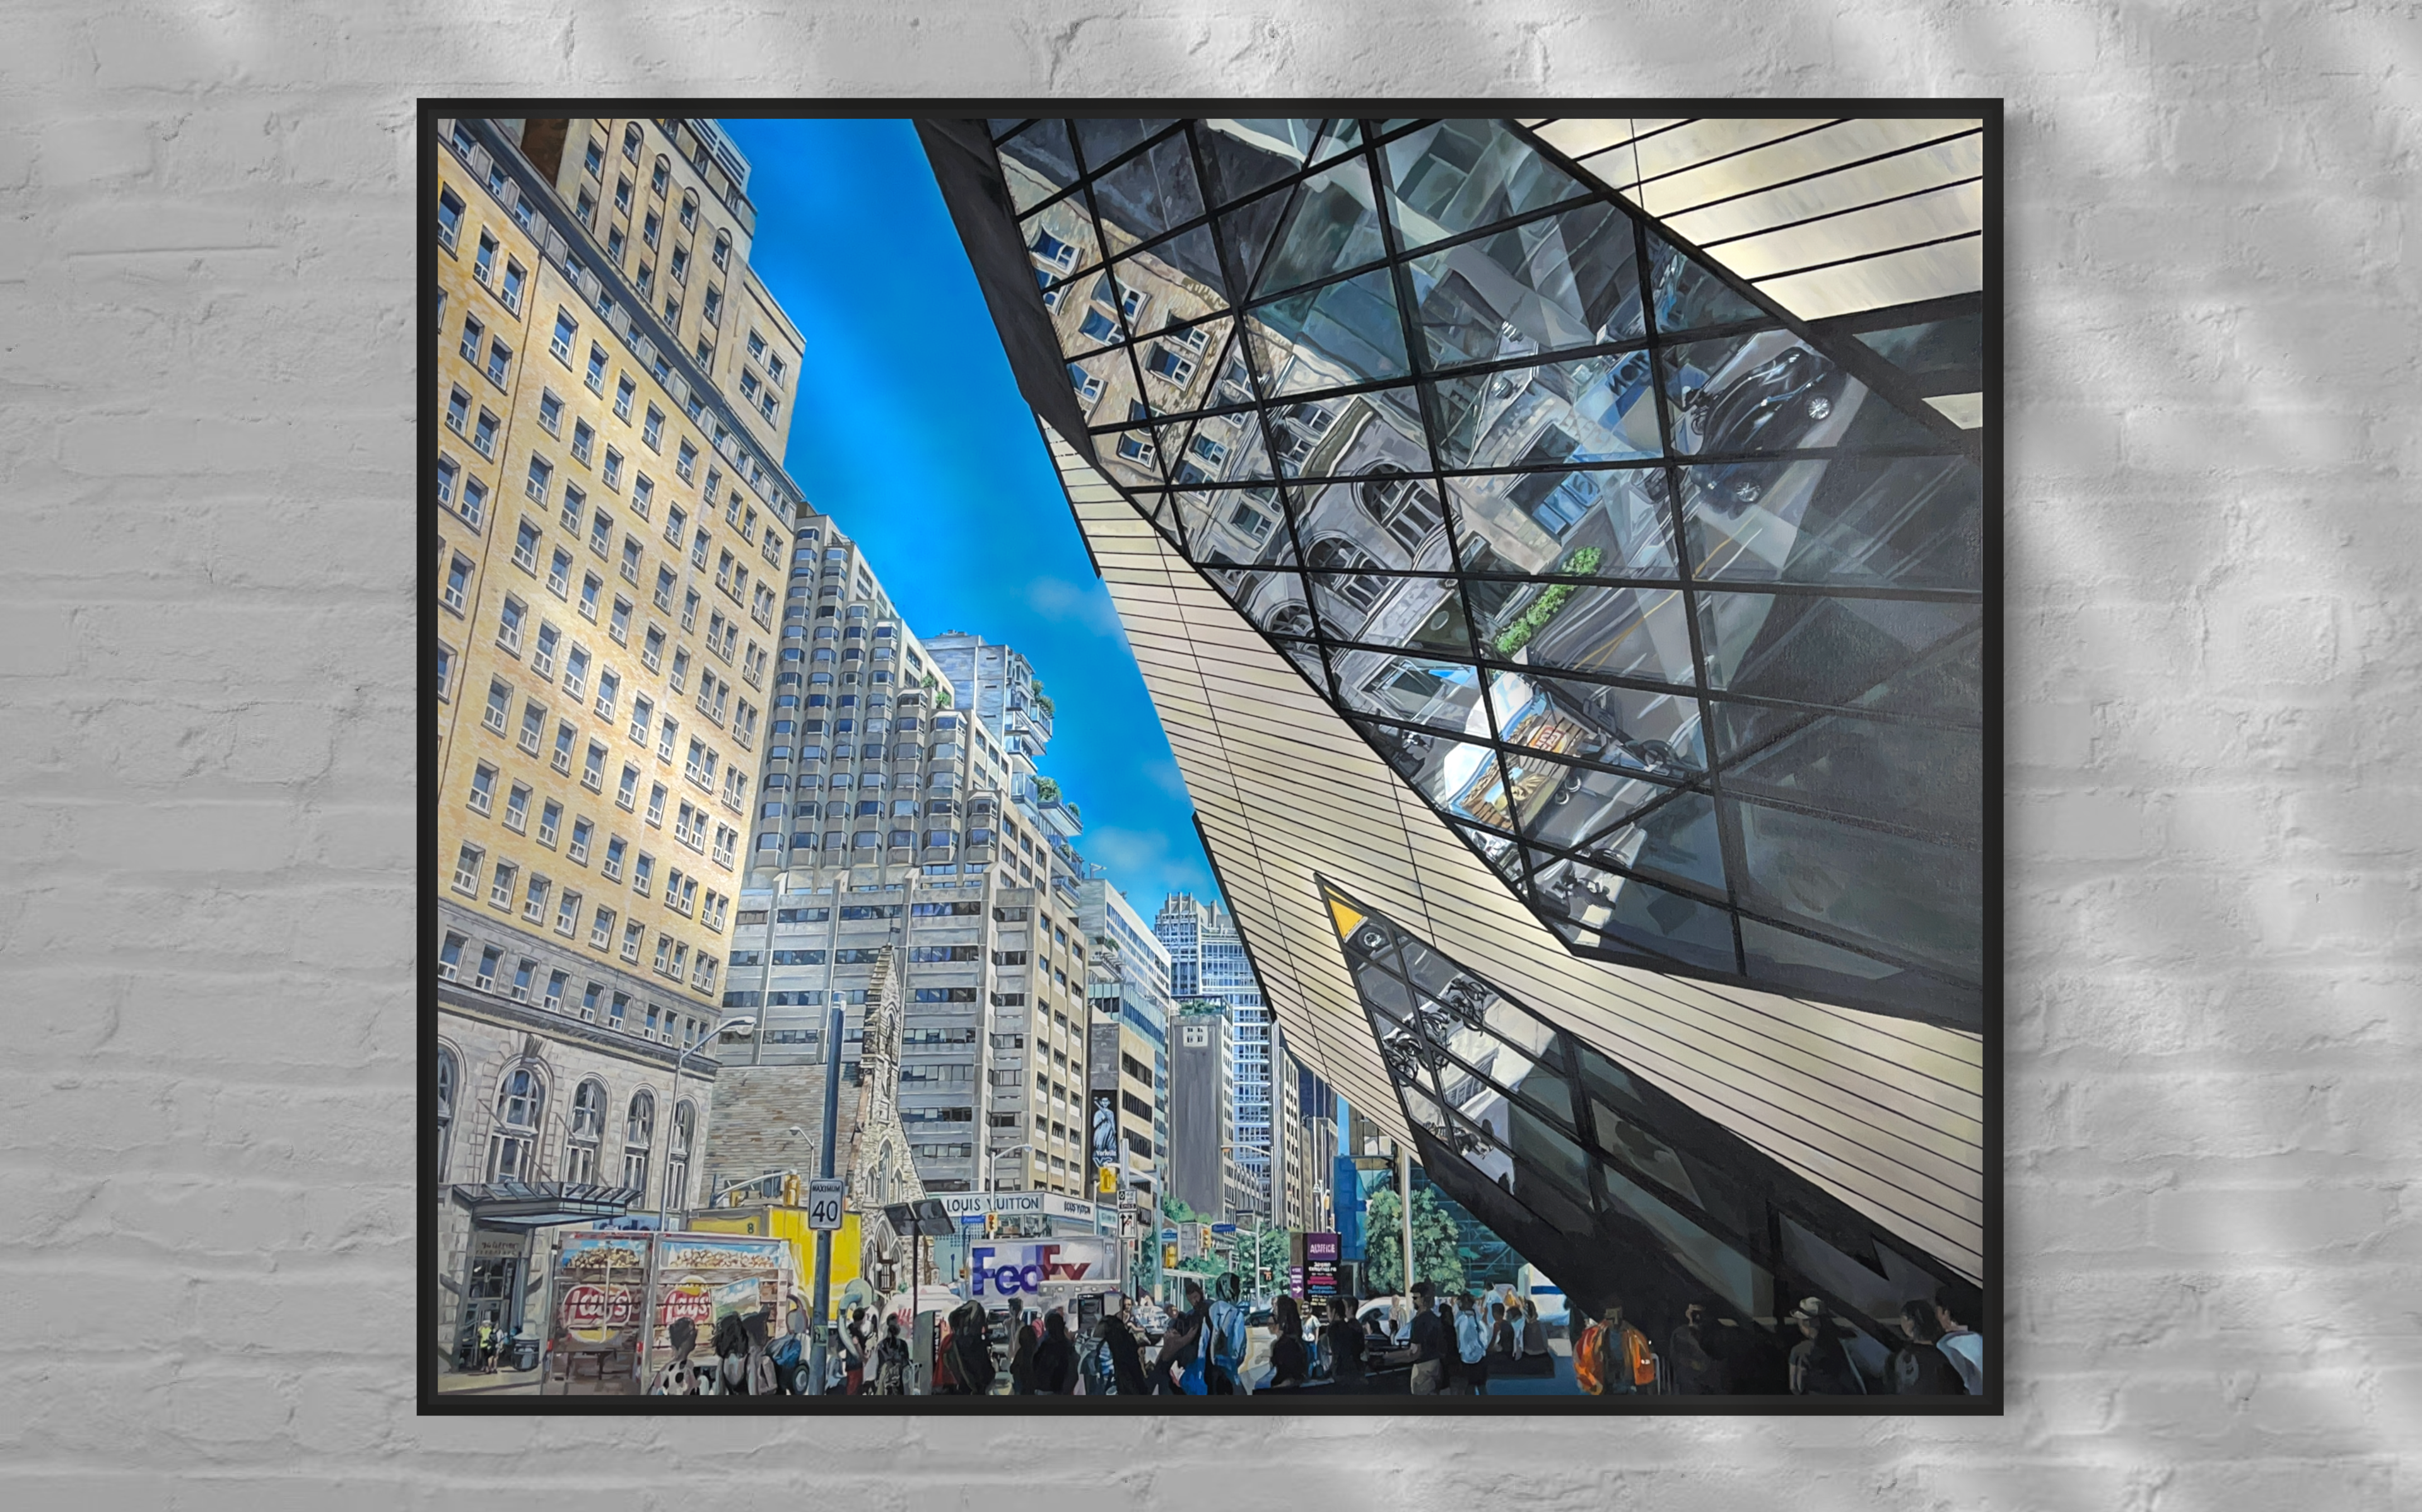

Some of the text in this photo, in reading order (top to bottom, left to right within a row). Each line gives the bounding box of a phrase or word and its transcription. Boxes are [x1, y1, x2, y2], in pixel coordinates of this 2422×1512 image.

[812, 1201, 838, 1222] 40
[947, 1198, 981, 1212] LOUIS
[747, 1223, 754, 1234] 8
[973, 1245, 1091, 1296] FedEx
